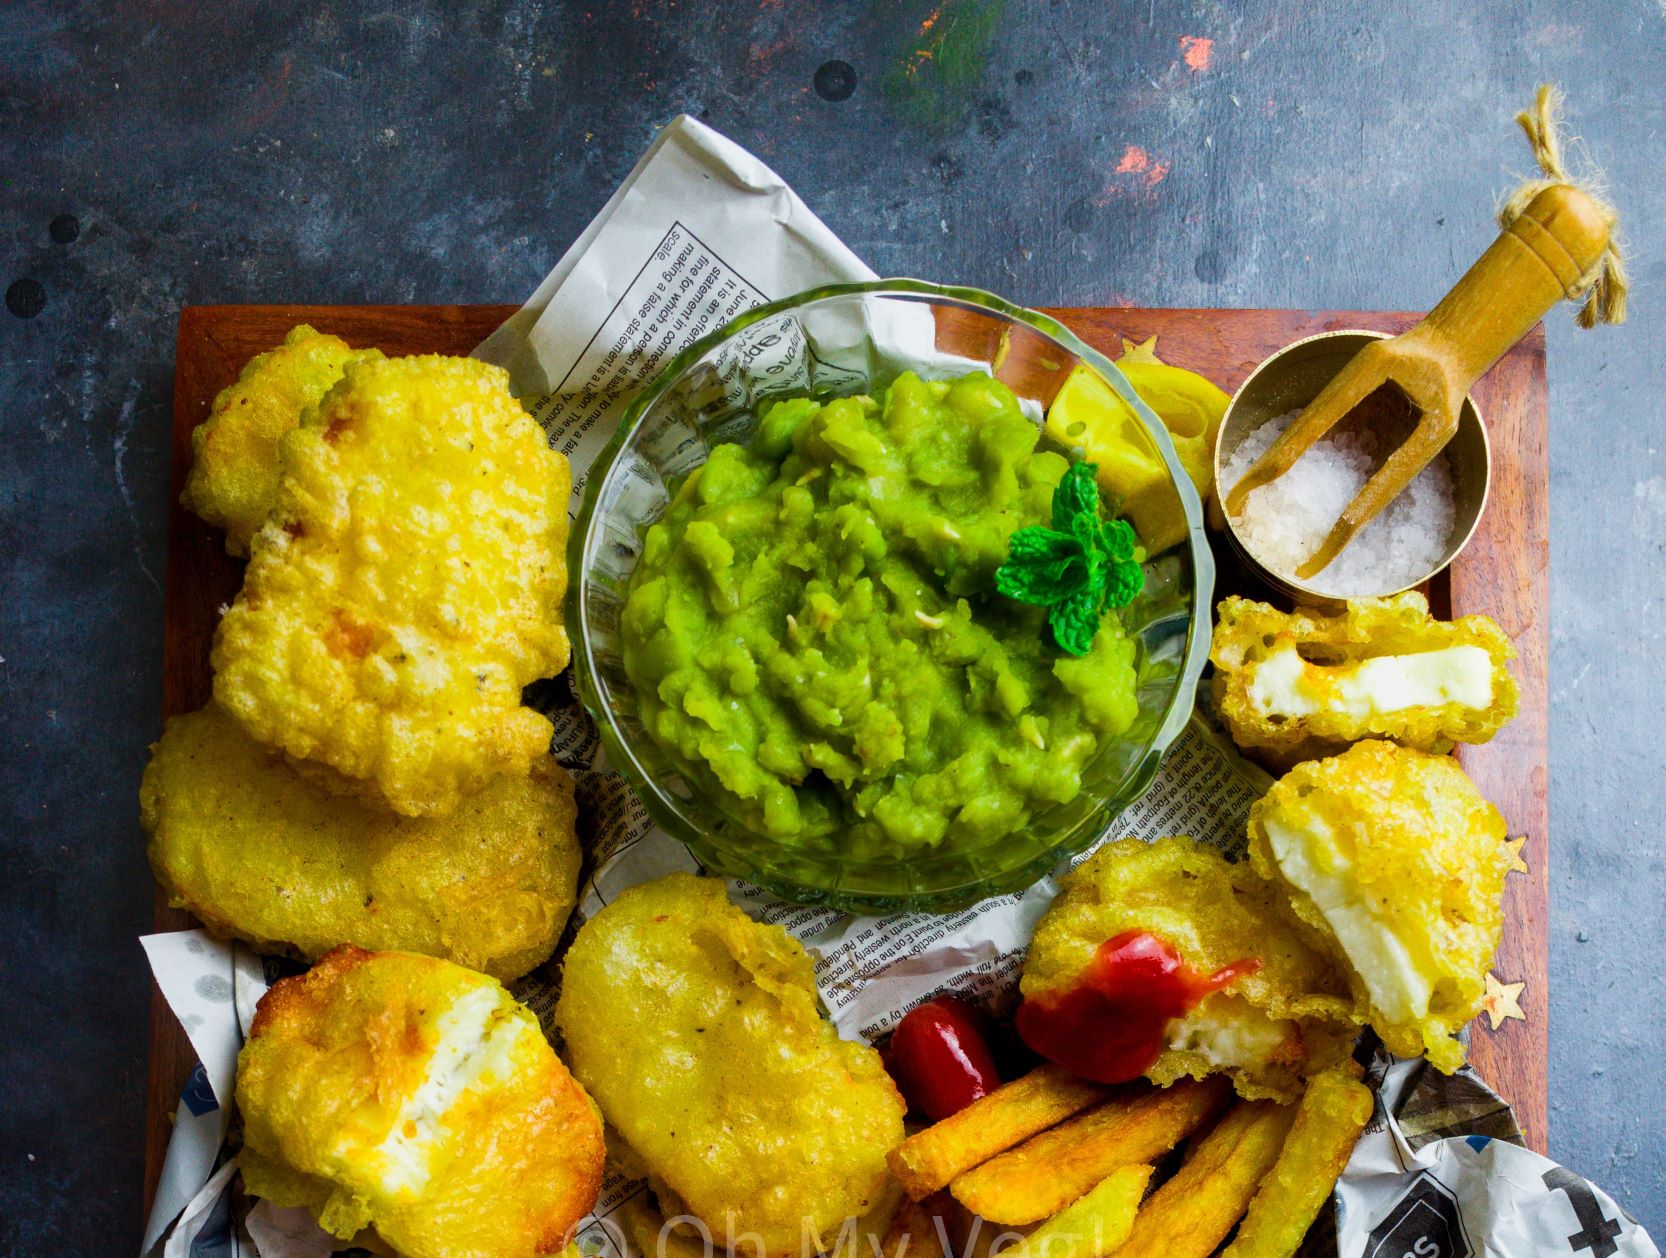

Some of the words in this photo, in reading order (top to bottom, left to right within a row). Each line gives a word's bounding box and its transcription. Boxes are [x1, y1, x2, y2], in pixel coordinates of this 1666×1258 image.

[653, 230, 680, 260] scale.
[661, 242, 694, 283] making
[689, 254, 709, 276] fine
[656, 282, 666, 292] a
[678, 275, 694, 294] for
[724, 278, 736, 289] It
[680, 266, 720, 320] statement
[717, 287, 730, 299] is
[638, 291, 661, 318] false
[655, 292, 681, 323] which
[705, 299, 719, 314] an
[724, 289, 747, 316] June
[648, 323, 658, 332] a
[672, 317, 687, 330] in
[601, 317, 640, 370] statement
[624, 330, 652, 366] person
[636, 330, 675, 379] connection
[590, 374, 600, 382] a
[596, 365, 609, 375] is
[618, 365, 631, 375] is
[533, 393, 551, 410] the
[598, 399, 611, 409] to
[561, 411, 582, 427] The
[579, 408, 602, 431] make
[572, 430, 582, 438] a
[1164, 771, 1174, 782] D
[1175, 762, 1203, 788] length
[1145, 780, 1165, 803] (grid
[1167, 786, 1177, 799] of
[1202, 779, 1223, 802] point
[1225, 782, 1242, 798] The
[1129, 801, 1144, 816] ref:
[1135, 794, 1170, 829] Footpath
[1155, 800, 1183, 828] metres
[1179, 803, 1200, 826] (grid
[1204, 795, 1227, 819] length
[1166, 821, 1182, 839] ref:
[1196, 816, 1207, 829] of
[888, 920, 912, 935] north
[944, 911, 978, 932] easterly
[855, 928, 873, 944] and
[904, 933, 914, 944] E
[910, 923, 933, 938] point
[853, 932, 891, 962] westerly
[892, 938, 906, 950] on
[907, 929, 944, 959] direction
[878, 947, 896, 961] the
[815, 957, 856, 988] direction
[843, 958, 880, 989] opposite
[976, 961, 991, 976] full
[994, 958, 1020, 980] under
[946, 969, 975, 986] width,
[977, 975, 994, 986] the
[826, 981, 845, 998] side
[933, 984, 947, 996] as
[879, 1017, 888, 1026] a
[889, 1009, 903, 1022] by
[858, 1023, 880, 1039] bold
[1364, 1121, 1384, 1135] The
[601, 1190, 623, 1207] from
